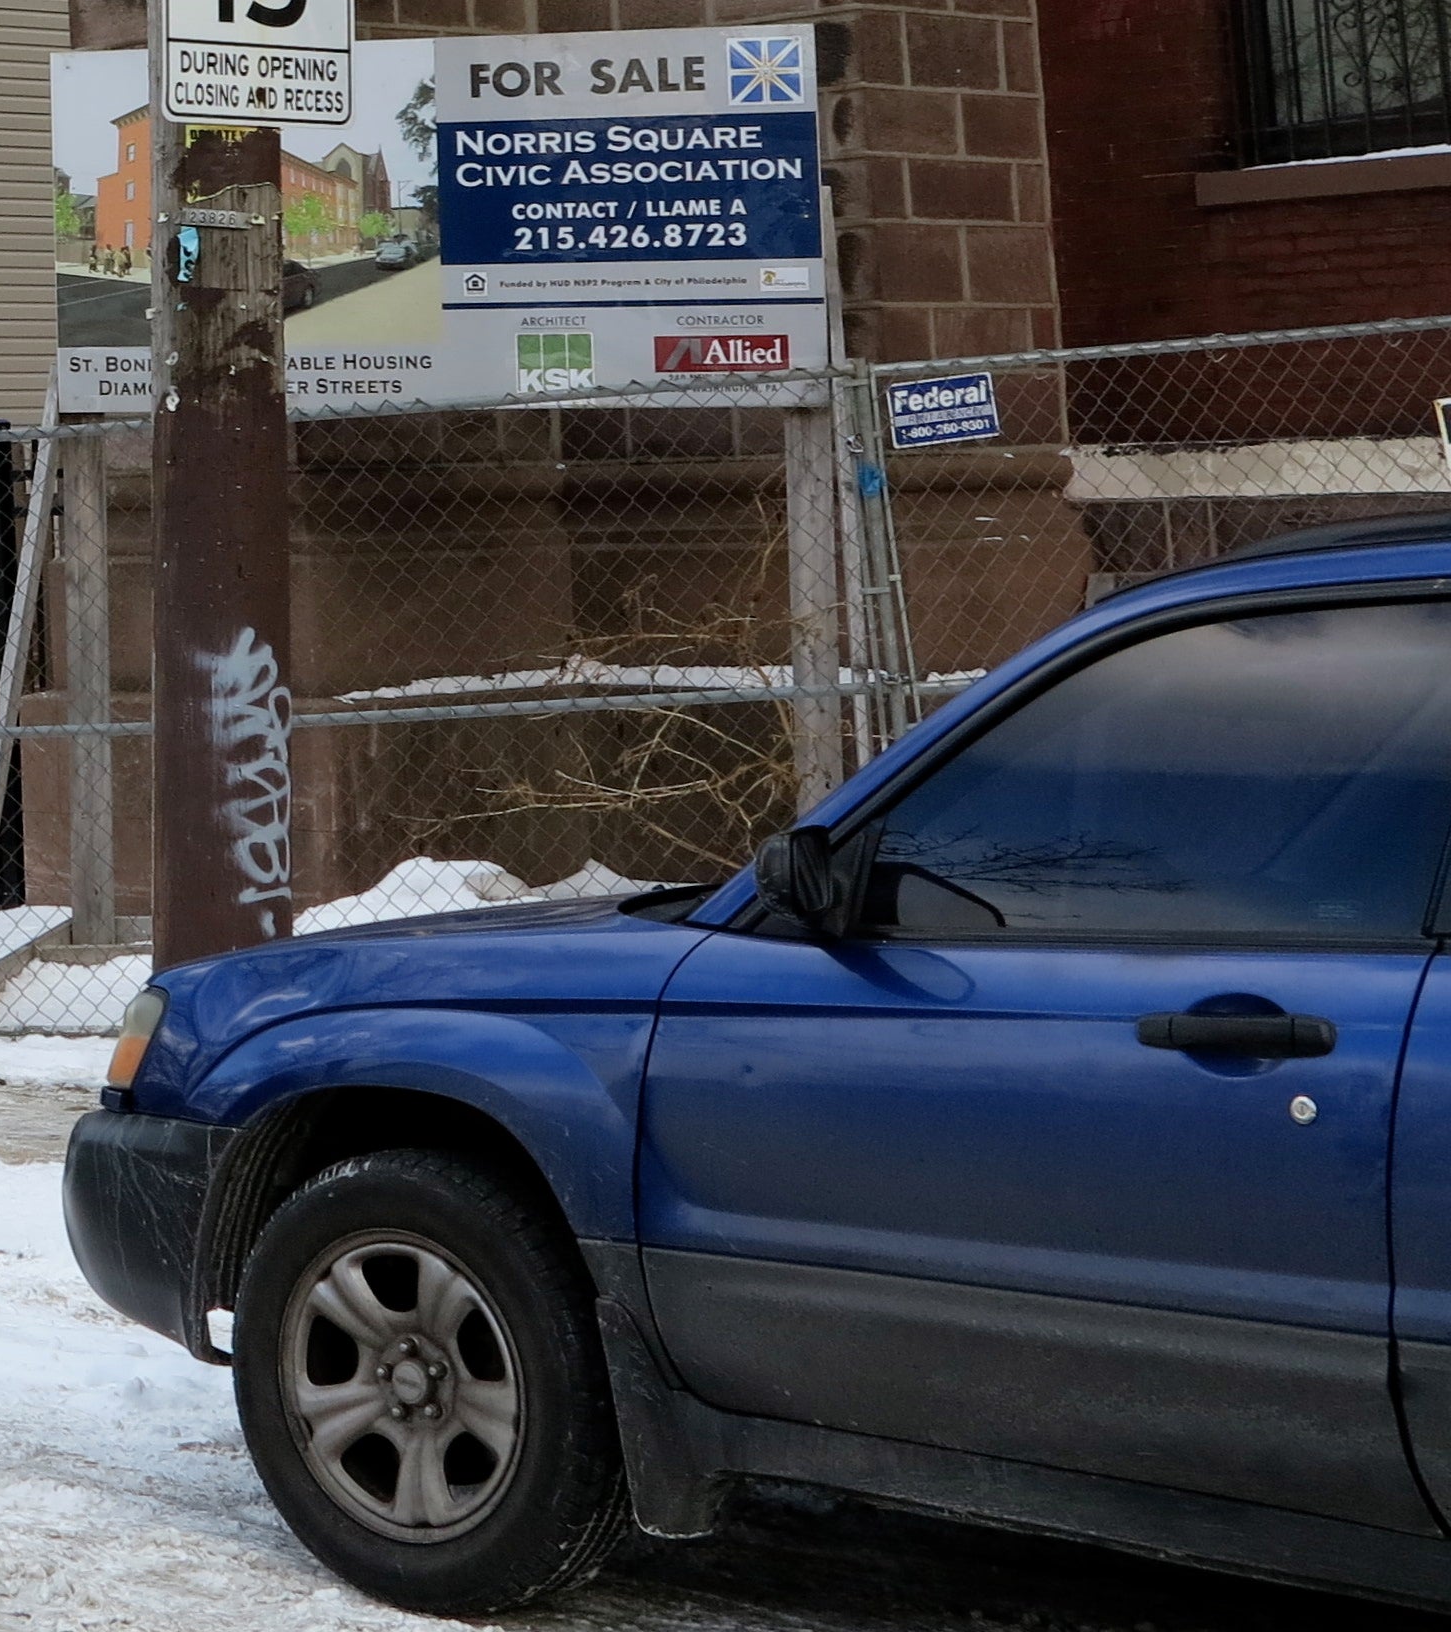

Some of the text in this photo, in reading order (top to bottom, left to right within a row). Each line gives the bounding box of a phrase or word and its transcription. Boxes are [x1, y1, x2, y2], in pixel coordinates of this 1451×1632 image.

[180, 50, 338, 82] DURING OPENING
[470, 56, 706, 98] FOR SALE
[175, 81, 240, 108] CLOSING
[284, 87, 344, 113] RECESS
[455, 125, 763, 156] NORRIS SQUARE
[455, 158, 803, 187] CIVIC ASSOCIATION
[190, 210, 237, 225] 23826
[512, 198, 747, 220] CONTACT / LLAME A
[514, 223, 748, 251] 215.426.8723
[499, 279, 534, 288] Funded
[536, 279, 547, 289] by
[549, 279, 571, 287] HUD
[601, 278, 641, 288] Program
[654, 277, 671, 287] City
[675, 277, 684, 285] of
[687, 276, 748, 286] Philadelphia
[521, 315, 586, 327] ARCHITECT
[676, 314, 764, 327] CONTRACTOR
[105, 356, 152, 373] BONI
[285, 355, 335, 370] ABLE
[343, 353, 432, 370] HOUSING
[703, 337, 783, 365] Allied
[99, 380, 152, 396] DIAM
[316, 379, 403, 395] STREETS
[517, 367, 596, 393] KSK
[893, 379, 987, 414] Federal
